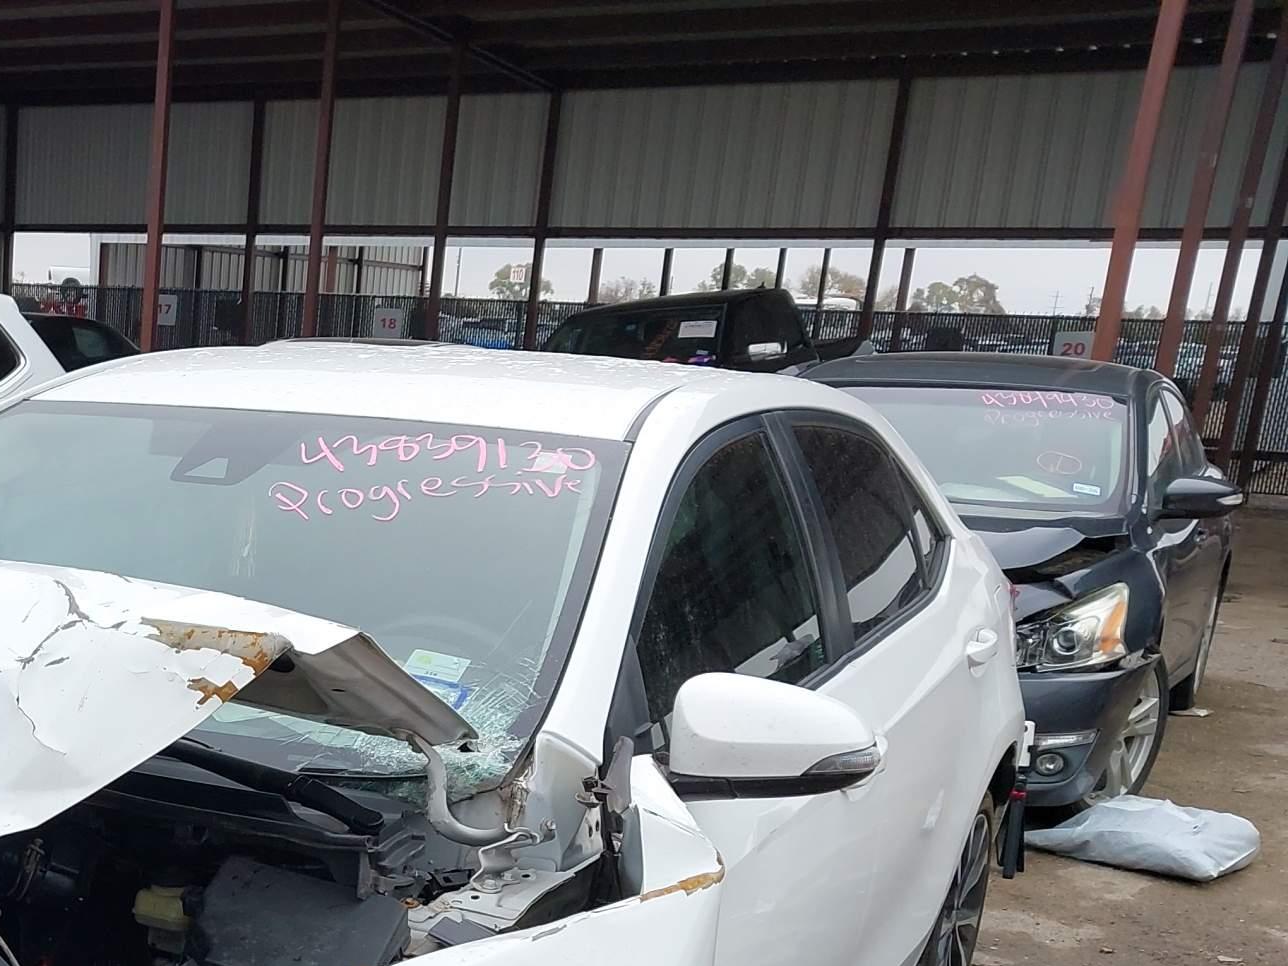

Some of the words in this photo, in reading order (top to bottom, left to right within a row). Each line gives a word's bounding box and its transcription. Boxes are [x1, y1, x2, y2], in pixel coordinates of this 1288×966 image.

[380, 318, 397, 329] 18
[1062, 342, 1086, 356] 20
[300, 433, 596, 473] 43839130
[268, 473, 583, 521] Progressive
